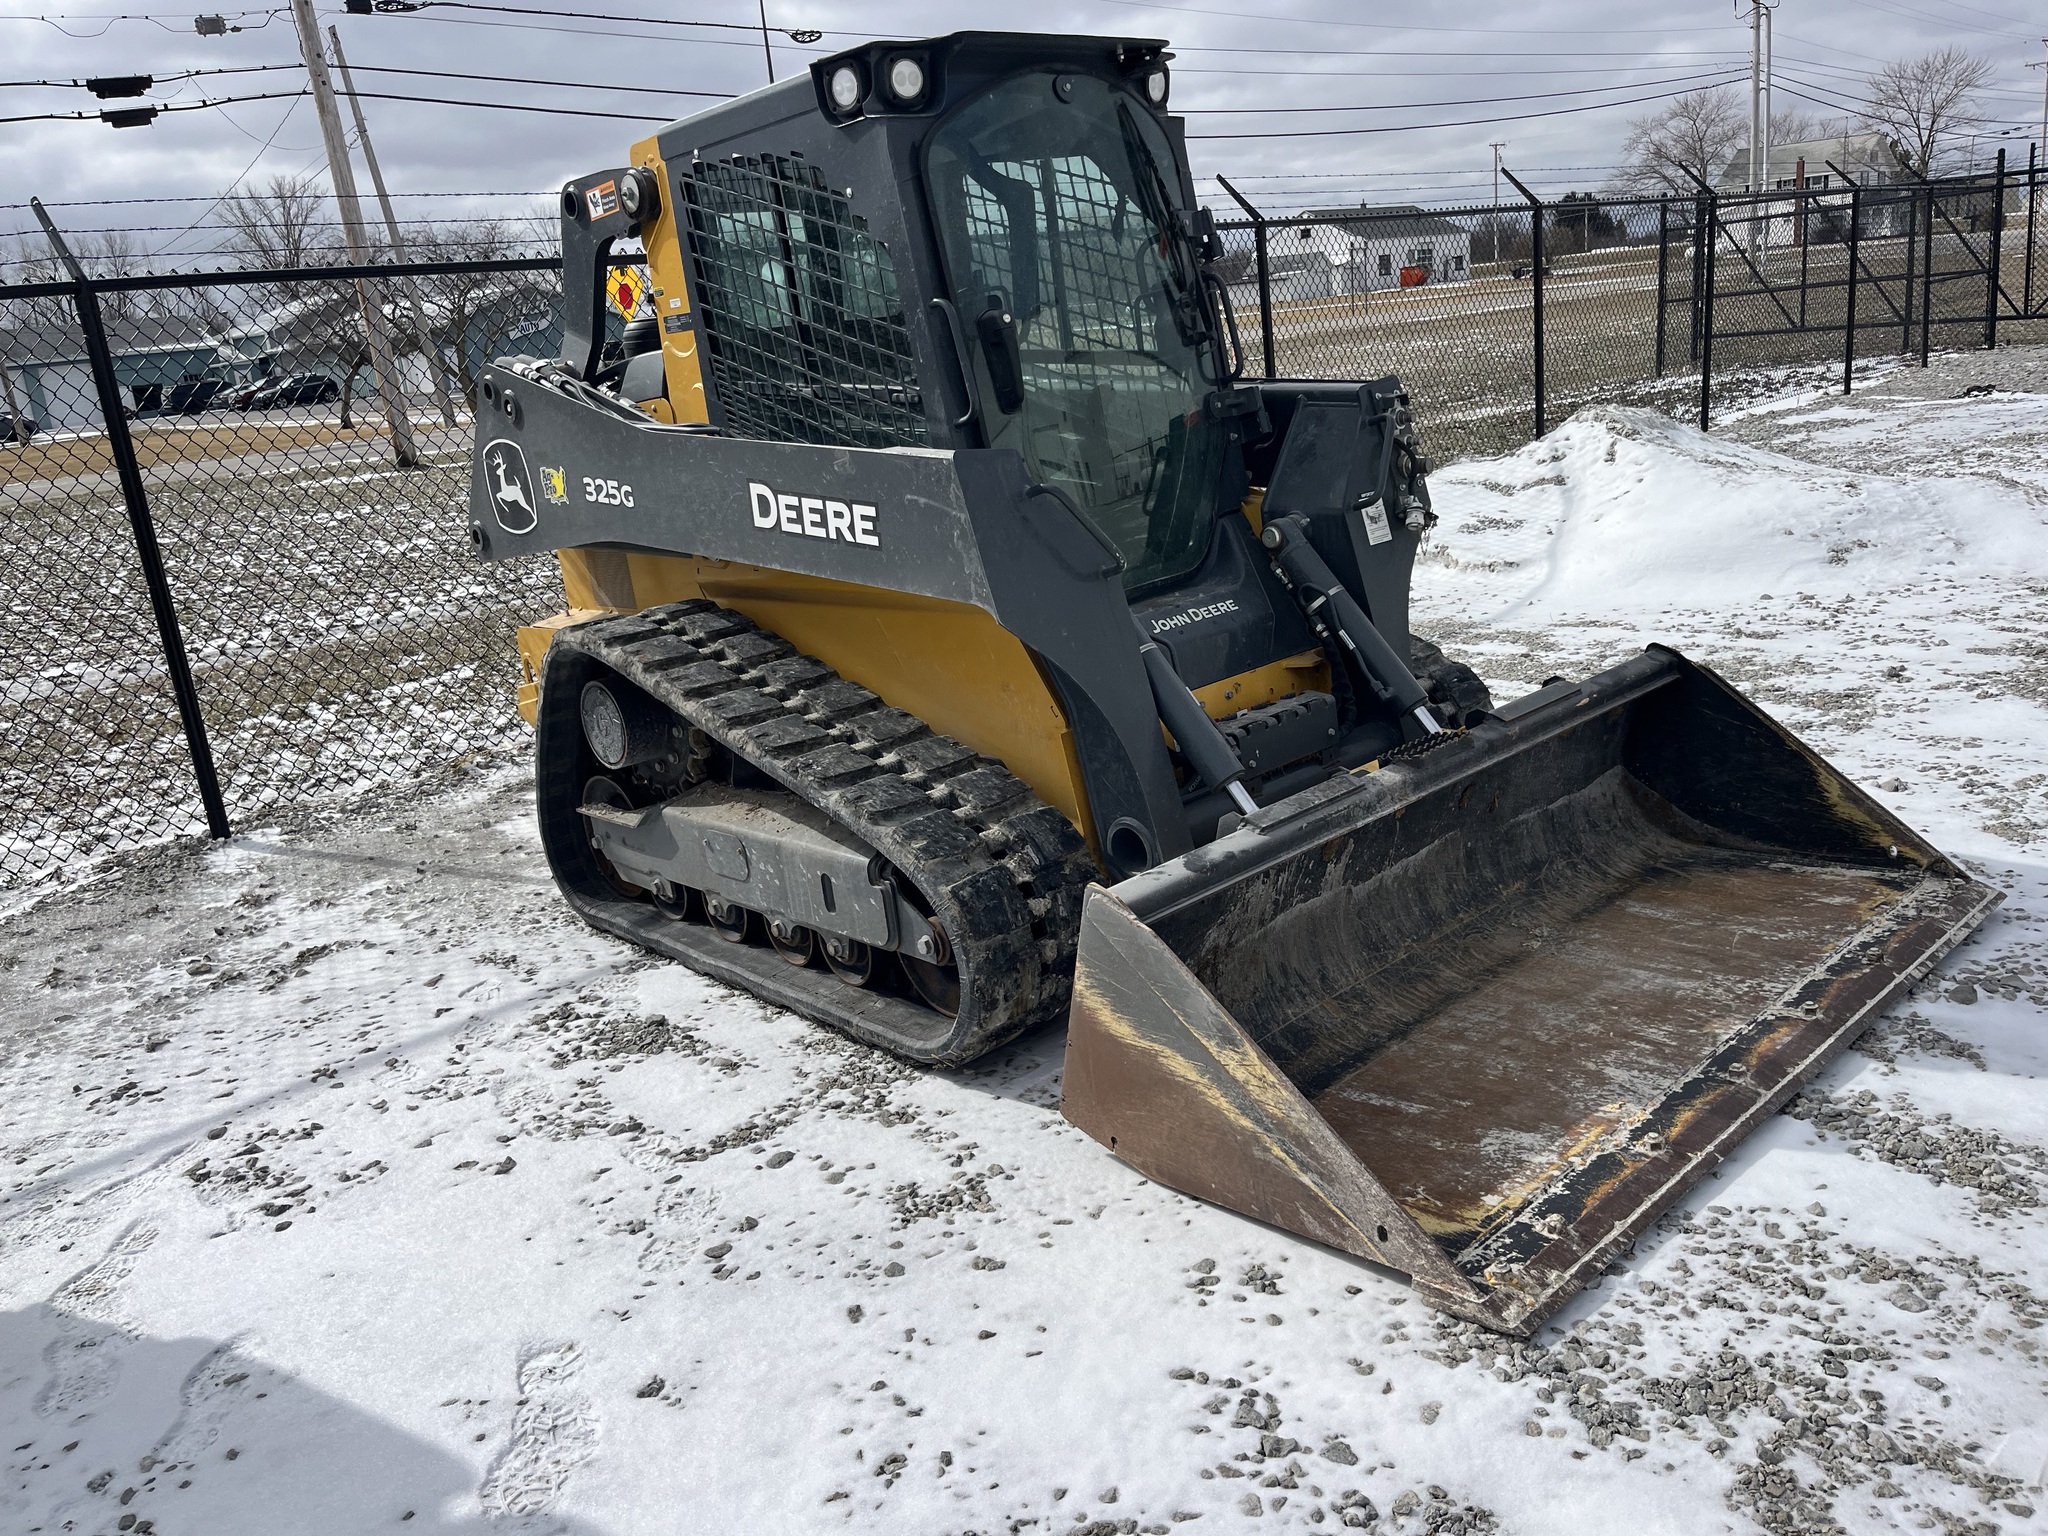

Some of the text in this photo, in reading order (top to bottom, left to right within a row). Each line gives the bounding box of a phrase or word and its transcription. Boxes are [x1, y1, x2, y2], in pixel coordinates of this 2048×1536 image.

[582, 476, 635, 508] 325G
[748, 482, 880, 547] DEERE
[1151, 599, 1239, 634] JOHN DEERE
